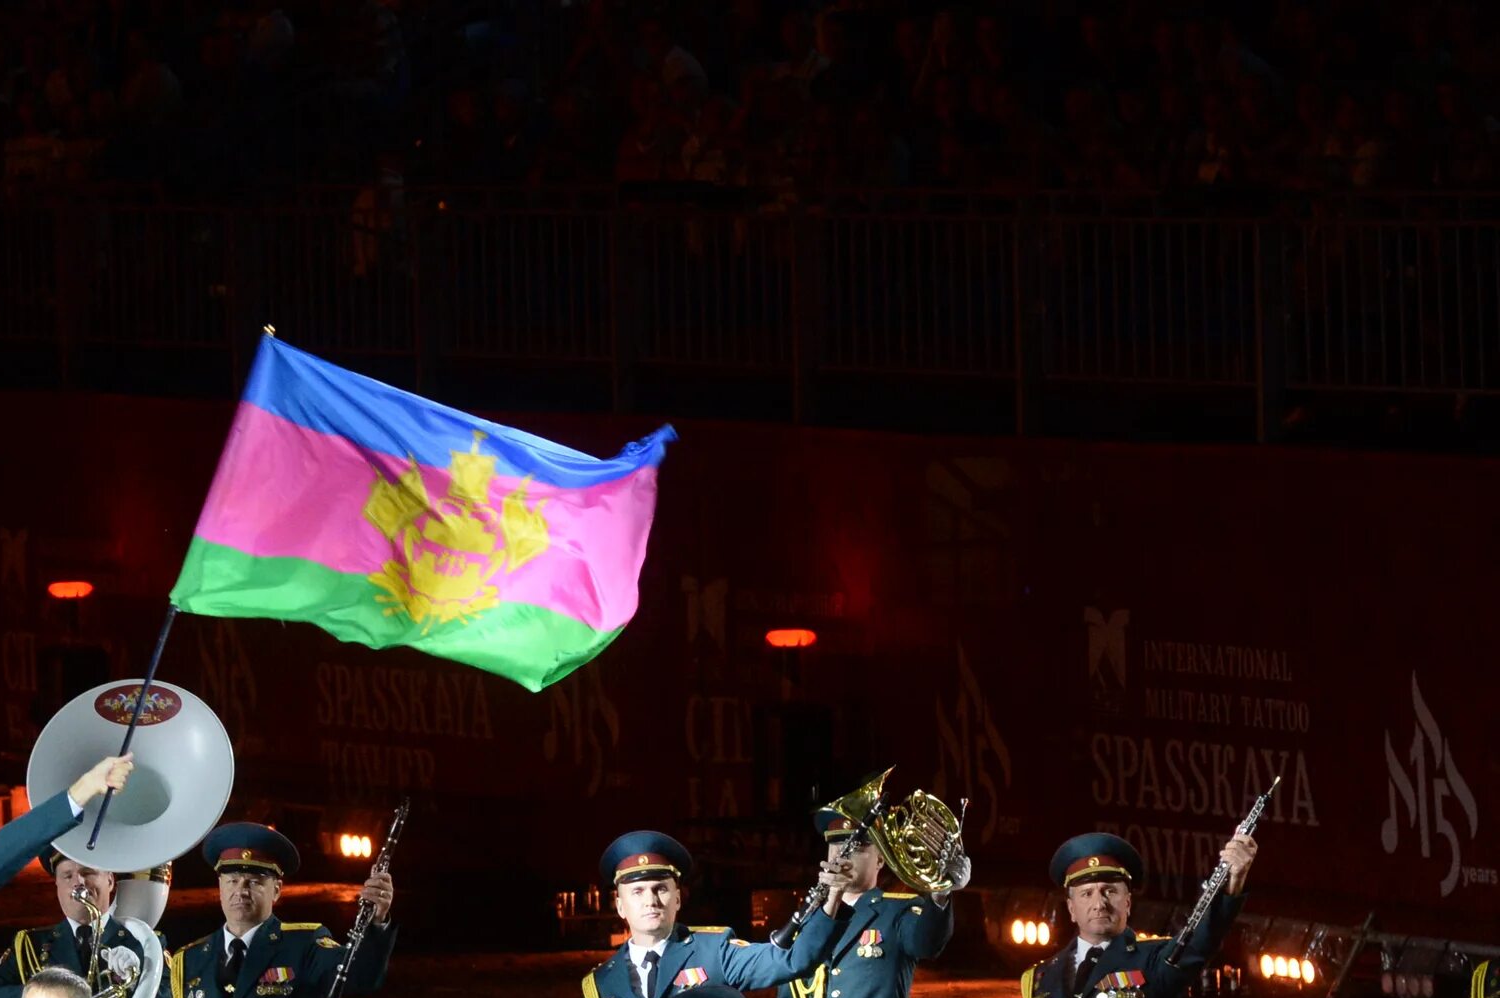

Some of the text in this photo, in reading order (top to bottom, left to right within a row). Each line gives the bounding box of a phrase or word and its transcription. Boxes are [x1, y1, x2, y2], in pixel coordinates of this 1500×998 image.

[1143, 639, 1292, 682] INTERNATIONAL
[316, 661, 495, 740] SPASSKAYA
[1145, 688, 1310, 733] MILITARY TATTOO
[1091, 732, 1320, 828] SPASSKAYA
[1462, 867, 1498, 895] years
